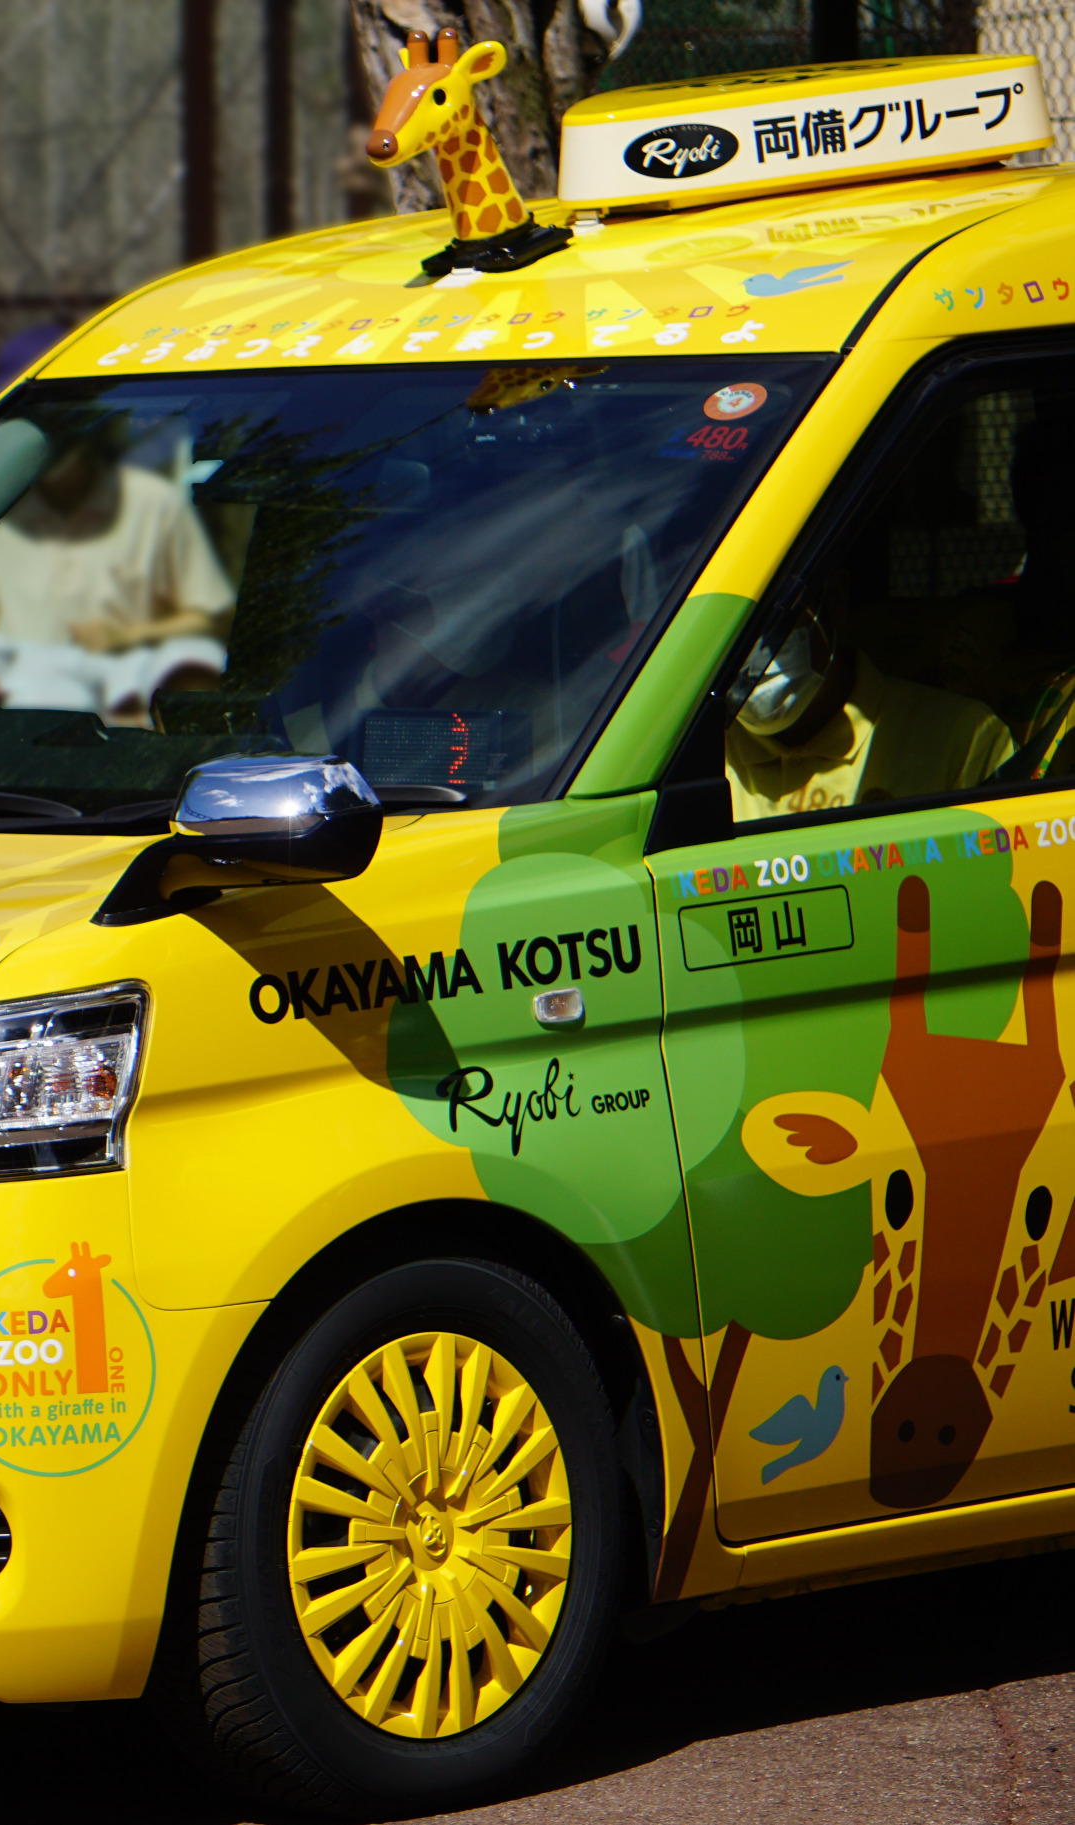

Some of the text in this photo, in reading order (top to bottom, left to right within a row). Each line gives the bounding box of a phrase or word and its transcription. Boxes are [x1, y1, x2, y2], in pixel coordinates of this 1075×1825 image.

[752, 82, 1024, 164] 両備グループ
[641, 133, 723, 177] Ryobi
[933, 277, 1070, 311] サンタロウ
[668, 863, 749, 899] IKEDA
[754, 854, 811, 887] ZOO
[817, 836, 942, 876] OKAYAMA
[954, 825, 1029, 860] IKEDA
[727, 900, 807, 957] 岡山
[249, 924, 643, 1025] OKAYAMA KOTSU
[435, 1057, 651, 1157] Ryobi GROUP
[108, 1346, 126, 1394] ONE
[30, 1404, 41, 1418] a
[47, 1398, 105, 1421] giraffe
[110, 1397, 127, 1414] in
